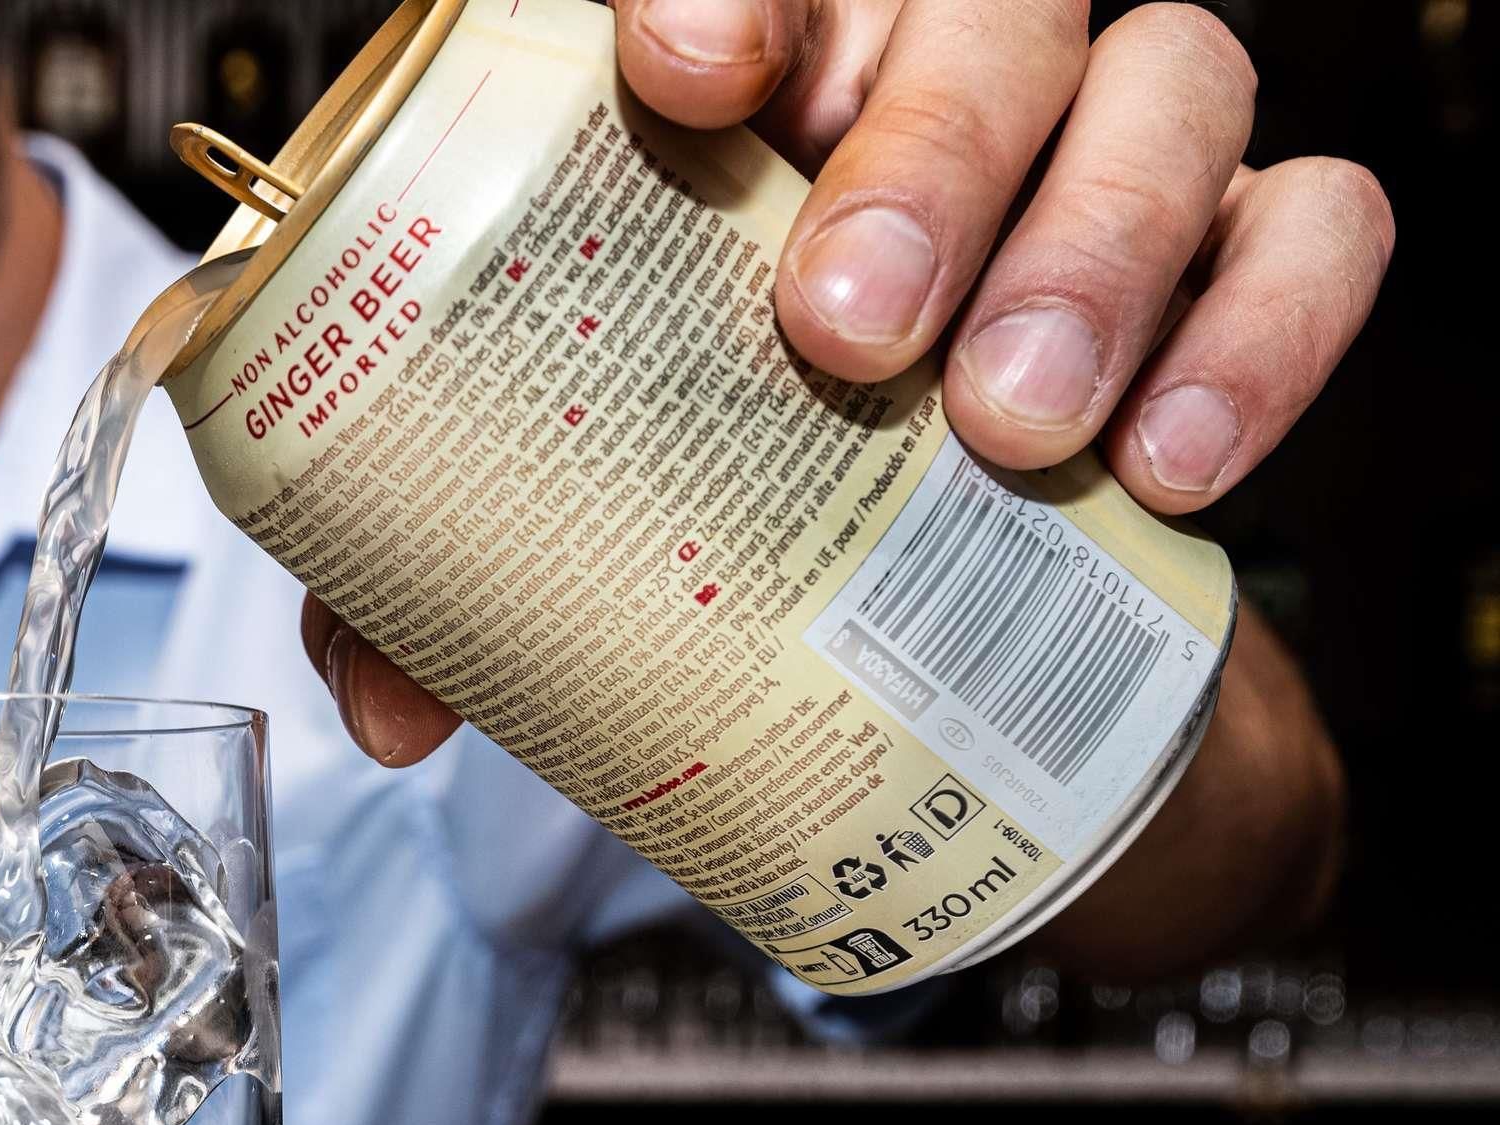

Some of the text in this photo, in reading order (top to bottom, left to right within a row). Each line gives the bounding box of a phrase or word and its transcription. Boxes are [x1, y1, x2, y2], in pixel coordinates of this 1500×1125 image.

[231, 203, 397, 396] NON ALCOHOLIC
[245, 323, 353, 440] GINGER
[350, 216, 442, 322] BEER
[286, 442, 344, 491] Ingredients:
[333, 414, 376, 447] Water,
[366, 383, 405, 417] sugar,
[395, 341, 436, 385] carbon
[425, 298, 477, 346] dioxide,
[468, 246, 510, 299] natural
[502, 210, 538, 257] ginger
[527, 151, 582, 215] flavouring
[571, 124, 594, 157] with
[309, 499, 351, 527] Wasser,
[335, 472, 380, 504] Zucker,
[366, 411, 439, 476] Kohlensäure,
[430, 343, 493, 412] natürliches
[482, 260, 558, 348] Ingweraroma
[566, 189, 607, 242] anderen
[385, 412, 464, 487] Stabilisatoren
[541, 278, 570, 309] 0%
[563, 258, 587, 285] vol.
[595, 171, 643, 236] Læskedrik
[294, 489, 326, 515] (citric
[318, 466, 351, 495] acid),
[341, 422, 393, 473] stabilisers
[382, 389, 426, 430] (E414,
[414, 352, 457, 392] E445).
[447, 330, 477, 354] Alc.
[466, 300, 496, 330] 0%
[489, 280, 515, 307] vol.
[503, 256, 533, 284] DE:
[298, 300, 422, 438] IMPORTED
[345, 526, 380, 552] Vand,
[369, 503, 411, 534] sukker,
[395, 453, 458, 507] kuldioxid,
[448, 408, 500, 459] naturlig
[561, 303, 586, 326] og
[575, 265, 610, 306] andre
[602, 210, 646, 269] naturlige
[389, 231, 685, 568] Eau, sucre, gaz carbonique, arôme naturel de gingembre et autres
[402, 266, 636, 534] stabilisatorer Boisson
[411, 229, 713, 581] stabilisant (E414, E445). 0% alcool. ES: Bebida refrescante aromatizada
[417, 224, 738, 599] Agua, azúcar, dióxido de carbono, aroma natural de jengibre y otros aromas
[451, 275, 734, 602] estabilizantes (E414, E445). 0% alcohol. Almacenar en un lugar
[465, 398, 682, 619] gusto zenzero. Ingredienti: Acqua, zucchero,
[510, 481, 644, 607] acidificante: acido citrico,
[571, 449, 906, 774] Produziert EU Produceret Produit pour Producido
[604, 568, 792, 737] stabilizatori (E414, E445). 0% alcool.
[1073, 546, 1163, 634] 711018
[1181, 640, 1199, 661] 5
[579, 670, 754, 789] Pagaminta ES. Gamintojas Vyrobeno
[623, 672, 783, 789] BRYGGERI Spegerborgvej 34,
[633, 810, 659, 822] See
[647, 802, 677, 817] base
[670, 793, 687, 808] of
[679, 787, 703, 803] can
[697, 745, 762, 790] Mindestens
[751, 713, 799, 750] haltbar
[788, 694, 819, 718] bis:
[692, 688, 855, 815] bunden dåsen consommer
[707, 727, 845, 828] Consumir preferentemente
[742, 718, 880, 834] preferibilmente entro: Vedi
[981, 754, 1047, 812] 1204RJ05
[745, 785, 871, 874] plechovky consuma
[852, 870, 869, 884] ALU
[994, 818, 1044, 861] 1026109-1
[742, 882, 812, 914] (ALLUMINIO)
[784, 920, 808, 933] tuo
[798, 900, 848, 927] Comune
[902, 856, 1017, 941] 330 ml
